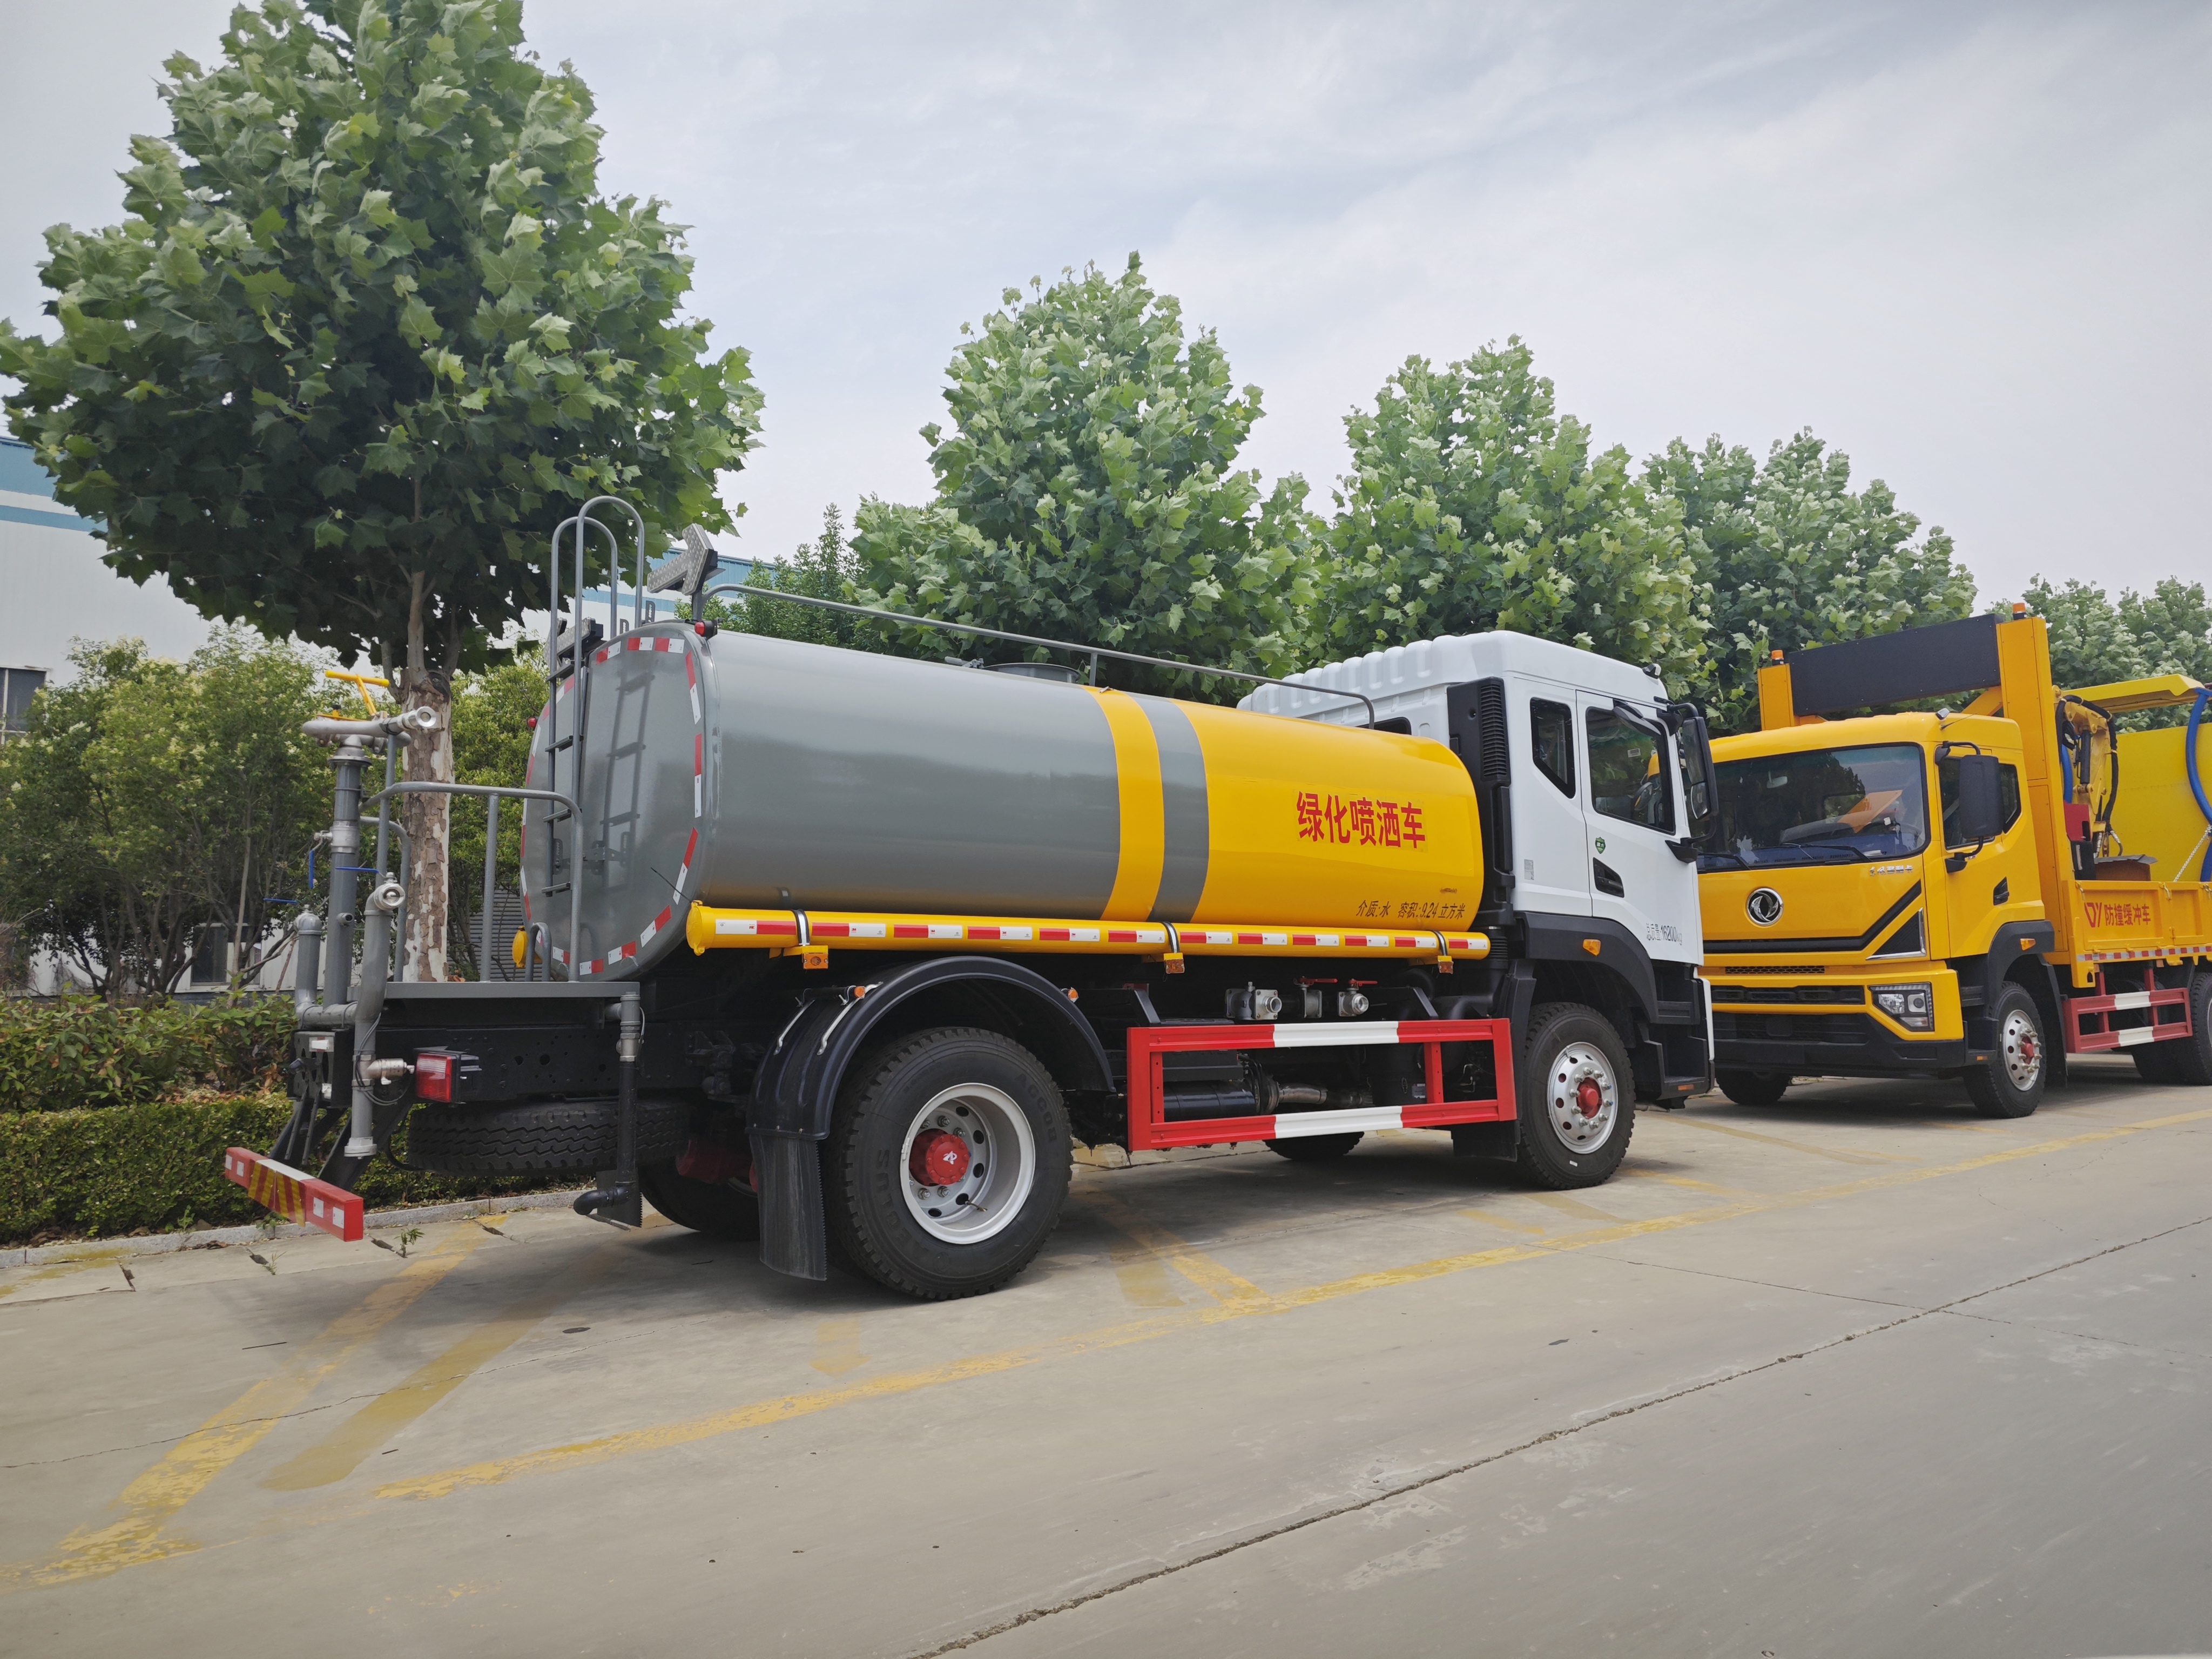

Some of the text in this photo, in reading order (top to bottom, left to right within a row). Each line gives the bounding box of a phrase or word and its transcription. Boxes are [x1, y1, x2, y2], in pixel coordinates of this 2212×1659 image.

[1297, 791, 1426, 848] 绿化喷洒车
[2104, 903, 2151, 926] 防撞缓冲车
